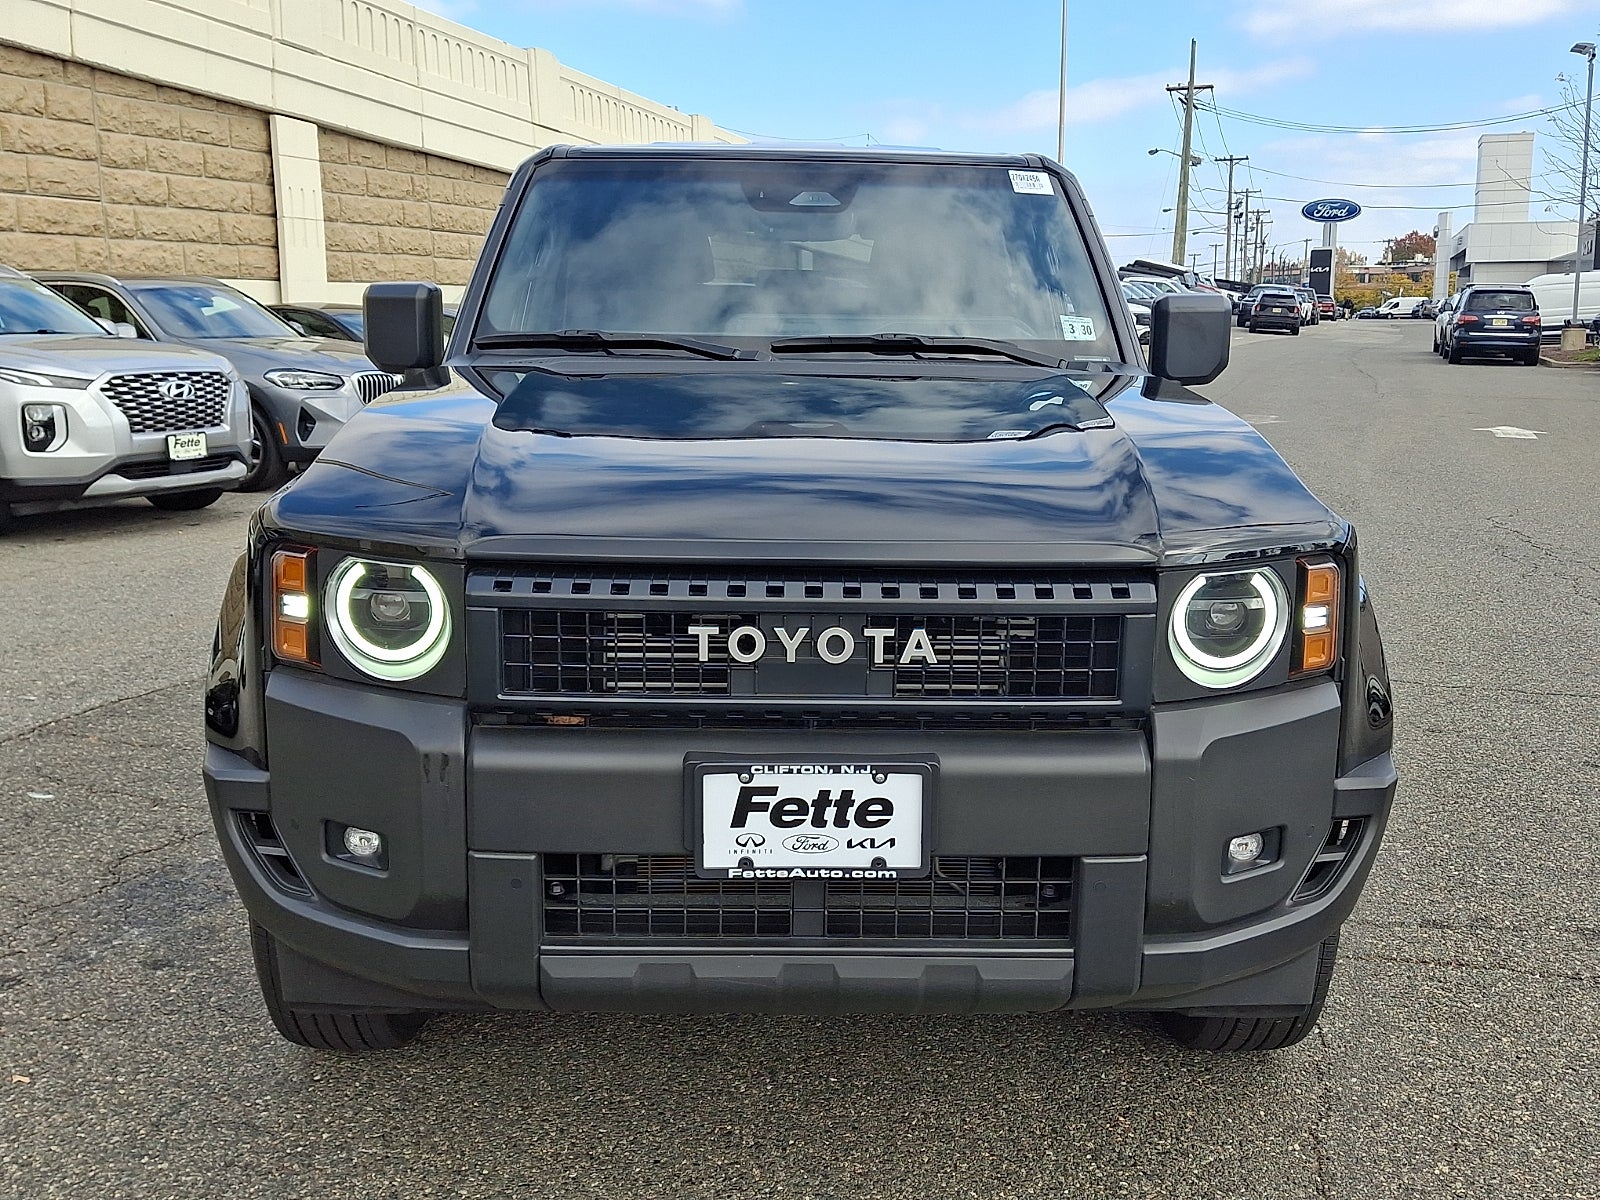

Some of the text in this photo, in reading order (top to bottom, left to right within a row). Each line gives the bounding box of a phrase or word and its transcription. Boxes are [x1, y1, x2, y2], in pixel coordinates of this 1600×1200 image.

[1313, 202, 1350, 217] Ford
[1068, 323, 1092, 335] 3 30
[173, 438, 200, 448] Fette
[687, 625, 938, 664] TOYOTA
[750, 764, 877, 776] CLIFTON, N.J.
[729, 786, 895, 829] Fette
[791, 835, 829, 851] Ford
[846, 837, 896, 849] KIA
[728, 868, 897, 879] FetteAuto.com
